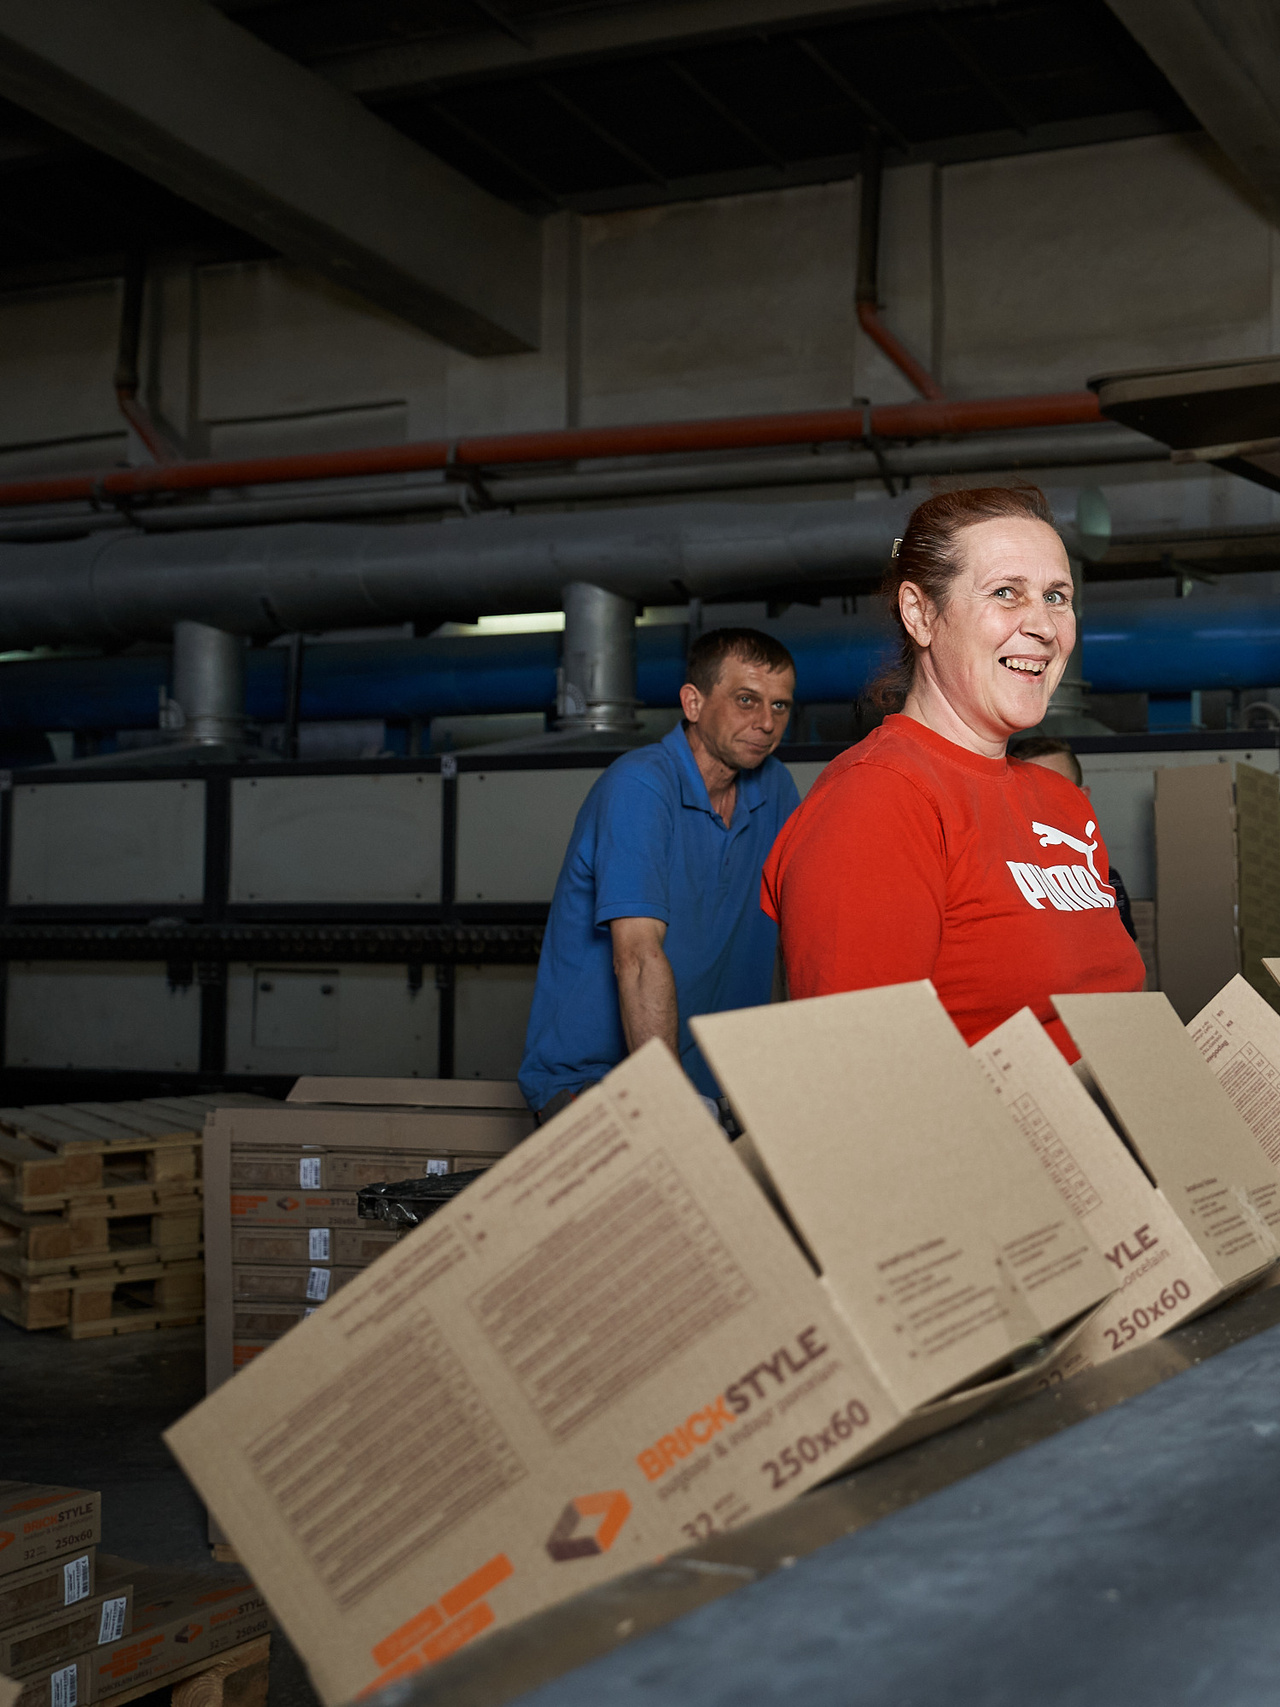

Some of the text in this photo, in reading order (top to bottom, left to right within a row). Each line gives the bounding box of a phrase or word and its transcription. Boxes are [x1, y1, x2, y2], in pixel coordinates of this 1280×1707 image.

[1006, 861, 1116, 912] PUMA
[1103, 1279, 1191, 1351] 250x60
[635, 1325, 829, 1484] BRICKSTYLE
[761, 1398, 871, 1491] 250x60
[23, 1502, 95, 1534] BRICKSTYLE
[55, 1529, 94, 1550] 250x60
